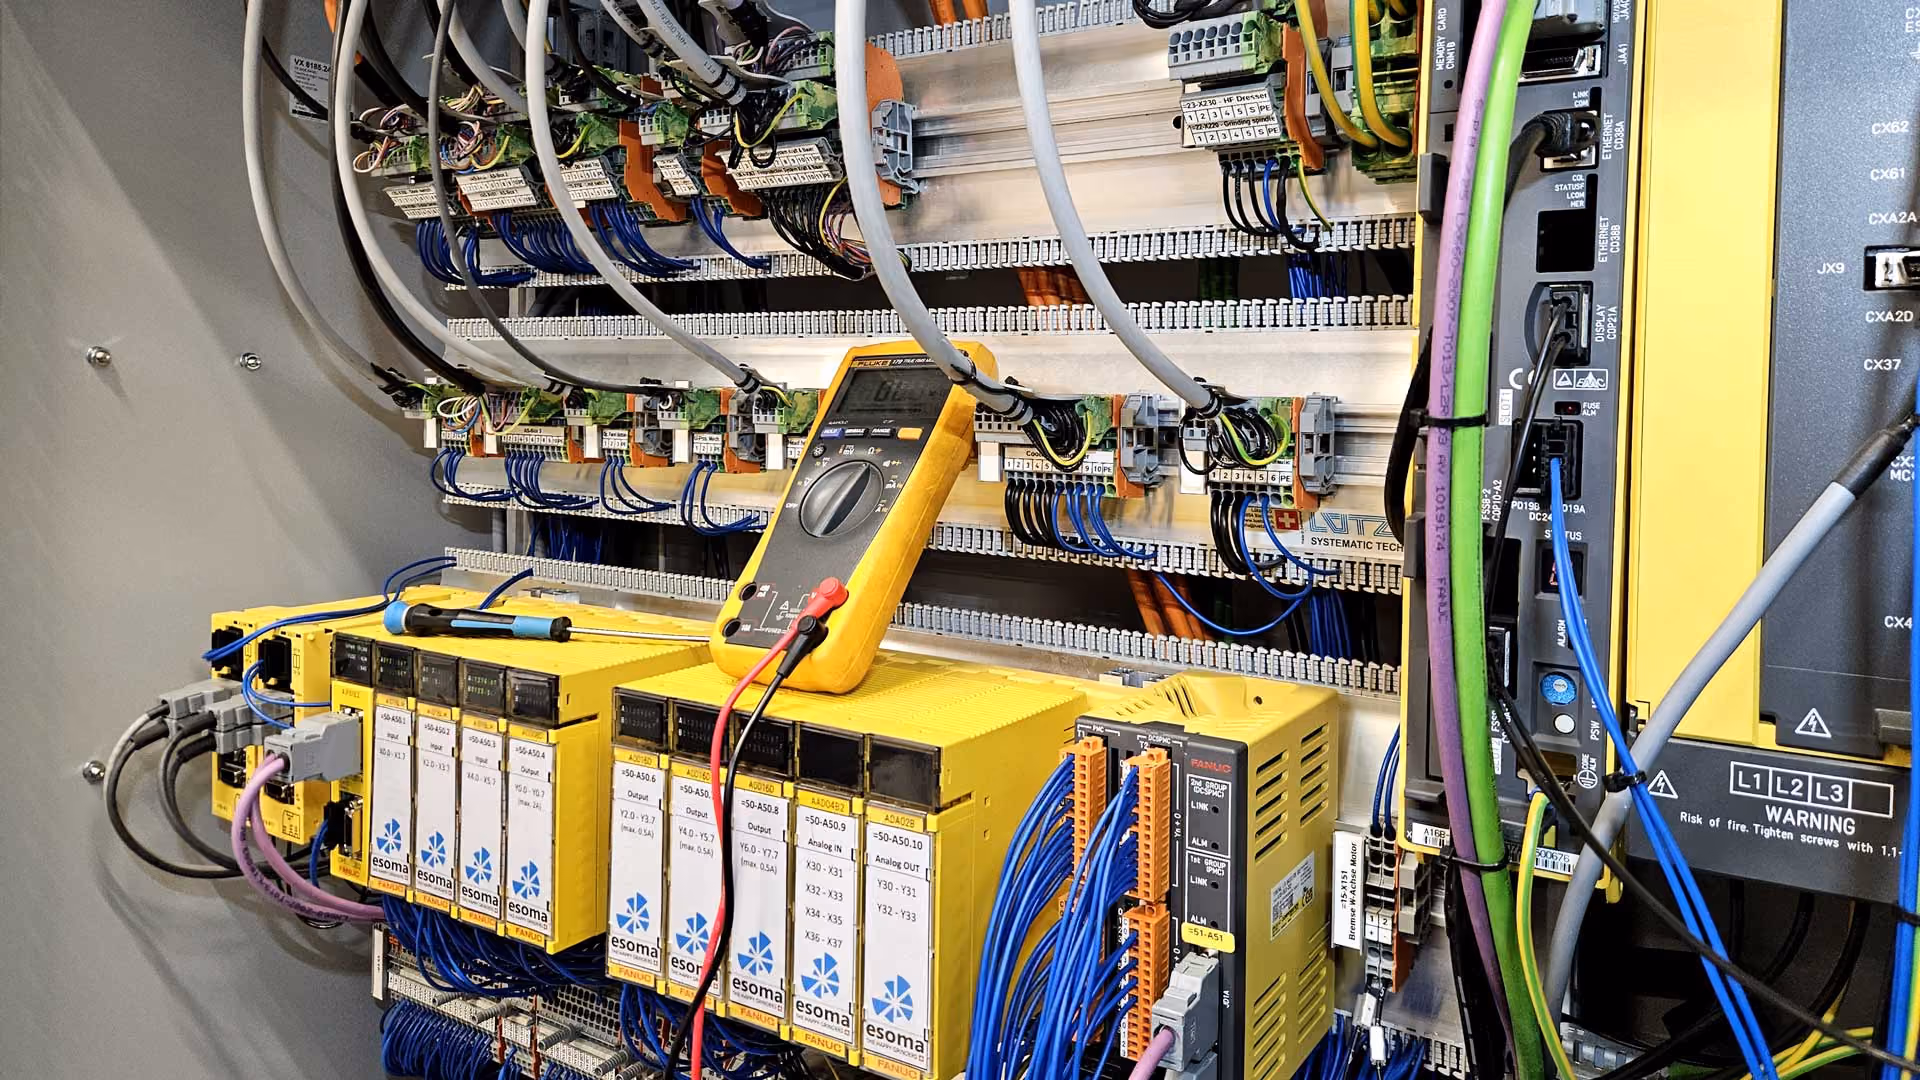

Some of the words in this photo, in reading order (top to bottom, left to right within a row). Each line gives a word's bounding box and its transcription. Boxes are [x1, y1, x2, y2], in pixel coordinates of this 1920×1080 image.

[1437, 7, 1447, 31] CARD
[1435, 33, 1446, 71] MEMORY
[1617, 43, 1628, 65] JA41
[294, 58, 305, 67] VX
[1223, 96, 1235, 104] HF
[1236, 92, 1268, 102] Dresser
[1572, 91, 1589, 100] LINK
[1574, 99, 1589, 108] COM
[1260, 104, 1271, 112] PE
[1268, 126, 1280, 135] PE
[1614, 120, 1625, 151] CD38A
[1871, 120, 1909, 135] CX62
[1602, 113, 1614, 160] ETHERNET
[1572, 174, 1585, 182] COL
[1870, 167, 1905, 181] CX61
[1868, 211, 1917, 225] CXA2A
[1597, 216, 1610, 263] ETHERNET
[1817, 262, 1845, 275] JX9
[1595, 304, 1606, 343] DISPLAY
[1607, 306, 1618, 340] COP21A
[1865, 310, 1914, 323] CXA2D
[1863, 358, 1902, 371] CX37
[1582, 409, 1597, 417] ALM
[1583, 402, 1601, 410] FUSE
[1481, 488, 1491, 521] FSSB-2
[1492, 479, 1503, 521] COP10-A2
[1435, 486, 1446, 551] 1019174
[1529, 512, 1553, 522] DC24
[1544, 530, 1582, 541] STTUS
[1311, 537, 1373, 550] SYSTEMATIC
[1375, 542, 1404, 553] TECH
[1557, 619, 1566, 648] ALARM
[1092, 725, 1105, 733] PMC
[1590, 720, 1601, 741] PSW
[429, 742, 444, 752] Input
[1139, 740, 1149, 749] T2
[474, 755, 489, 765] Input
[1190, 758, 1232, 774] FANUC
[520, 765, 540, 777] Output
[621, 770, 657, 783] =50-A50.6
[680, 785, 712, 799] =50-A50.
[1190, 778, 1202, 788] 2nd
[1205, 781, 1228, 792] GROUP
[1738, 770, 1761, 790] L1
[1776, 777, 1804, 797] L2
[1816, 783, 1844, 803] L3
[627, 790, 649, 802] Output
[686, 807, 709, 819] Output
[740, 800, 779, 815] =50-A50.8
[1191, 802, 1209, 812] LINK
[620, 809, 635, 820] Y2.0
[641, 813, 656, 825] Y3.7
[805, 815, 847, 832] =50-A50.9
[1765, 804, 1856, 836] WARNING
[620, 824, 637, 835] (max.
[638, 827, 654, 838] 0.5A)
[678, 825, 694, 838] Y4.0
[699, 830, 715, 843] Y5.7
[747, 822, 772, 835] Output
[1680, 811, 1703, 825] Risk
[1709, 817, 1721, 828] of
[1727, 819, 1749, 834] fire.
[1753, 823, 1794, 841] Tighten
[1800, 833, 1840, 849] screws
[1847, 841, 1873, 854] with
[679, 841, 695, 852] (max.
[697, 844, 714, 858] 0.5A)
[808, 838, 833, 852] Analog
[834, 844, 843, 853] IN
[873, 832, 923, 851] =50-A50.10
[1191, 838, 1208, 849] ALM
[739, 842, 756, 854] Y6.0
[762, 846, 779, 860] Y7.7
[1350, 842, 1358, 864] Motor
[372, 857, 409, 874] esoma
[740, 857, 758, 869] (max.
[760, 860, 777, 875] 0.5A)
[805, 859, 822, 872] X30
[828, 864, 843, 878] X31
[875, 854, 902, 870] Analog
[903, 861, 920, 873] OUT
[1204, 858, 1227, 869] GROUP
[1205, 865, 1225, 877] (PMC)
[417, 867, 453, 890] esoma
[1190, 876, 1208, 887] LINK
[461, 885, 499, 907] esoma
[805, 883, 822, 896] X32
[827, 889, 844, 902] X33
[877, 878, 894, 892] Y30
[901, 885, 917, 898] Y31
[1340, 870, 1348, 910] =15-X151
[1349, 869, 1357, 910] W-Achse
[423, 895, 449, 910] FANUC
[468, 911, 496, 927] FANUC
[508, 900, 548, 924] esoma
[805, 907, 821, 919] X34
[827, 912, 843, 926] X35
[877, 903, 893, 917] Y32
[901, 909, 917, 923] Y33
[1190, 914, 1207, 926] ALM
[1348, 911, 1357, 941] Bremse
[515, 927, 543, 943] FANUC
[804, 929, 821, 943] X36
[827, 935, 843, 949] X37
[611, 936, 658, 959] esoma
[618, 967, 652, 982] FANUC
[732, 976, 783, 1004] esoma
[740, 1008, 775, 1026] FANUC
[795, 999, 850, 1028] esoma
[804, 1033, 843, 1053] FANUC
[866, 1022, 925, 1054] esoma
[877, 1059, 918, 1080] FANUC
